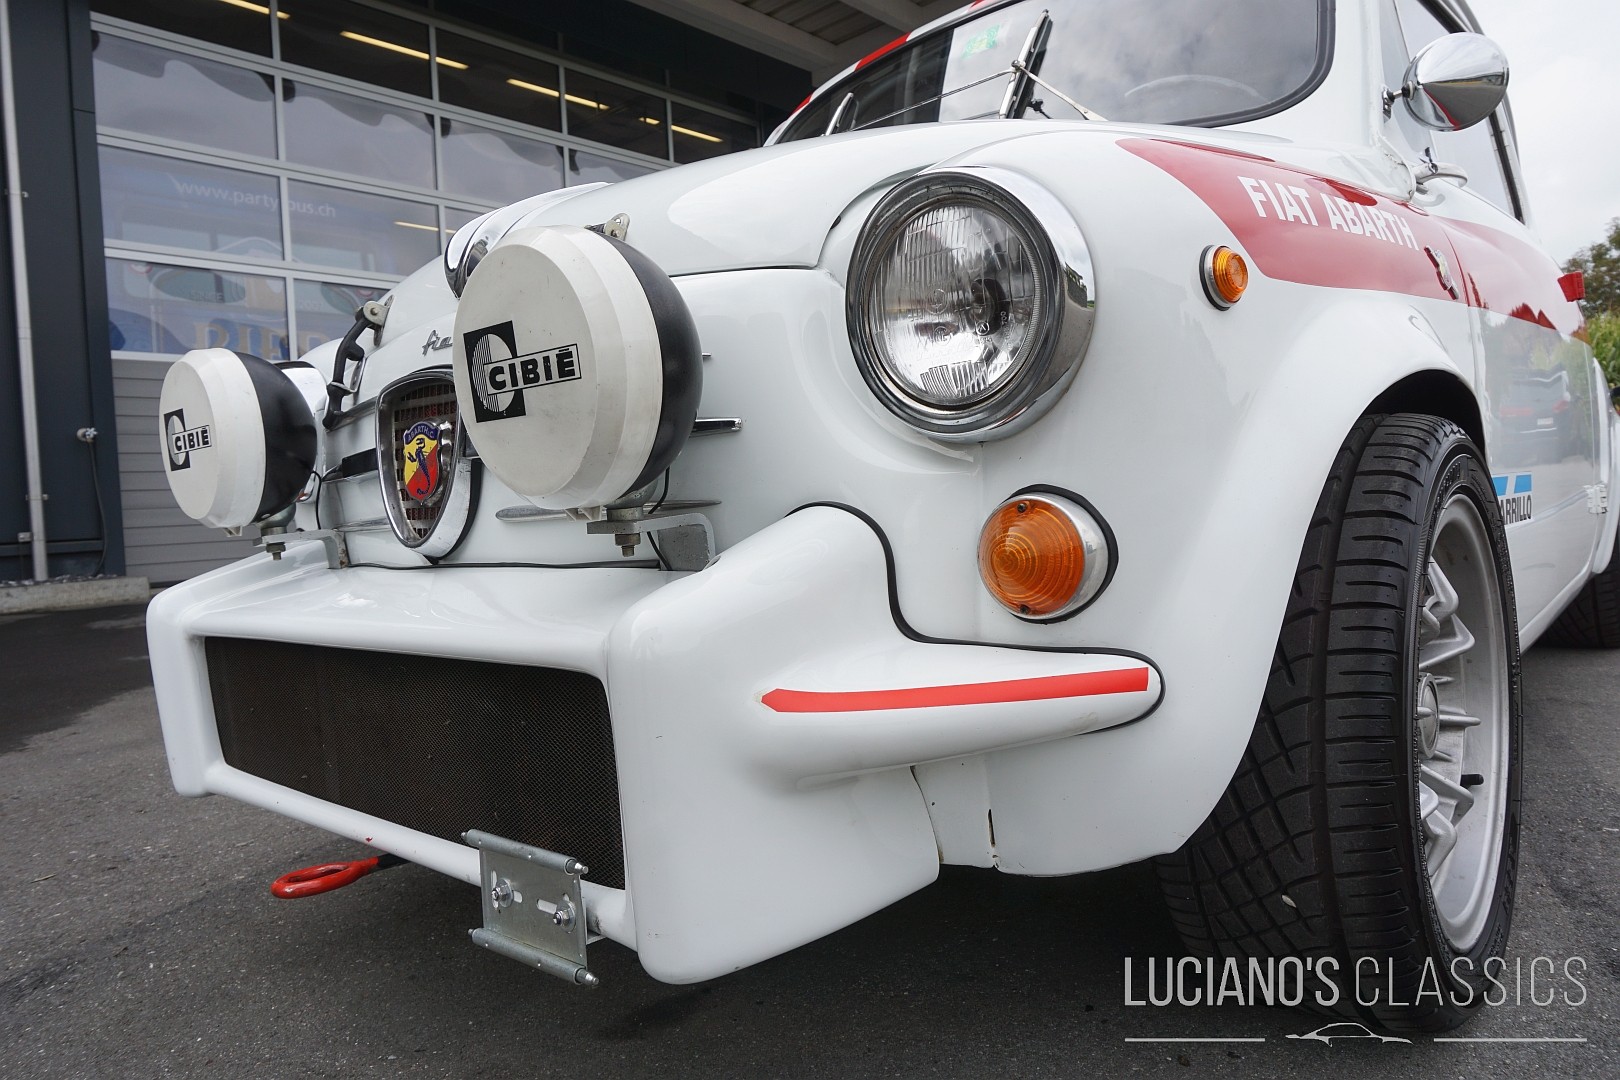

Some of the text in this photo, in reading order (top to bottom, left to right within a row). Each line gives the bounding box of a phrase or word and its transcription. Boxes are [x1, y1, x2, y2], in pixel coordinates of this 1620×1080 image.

[1237, 176, 1420, 251] FIAT ABARTH
[1499, 494, 1533, 525] ARRILLO
